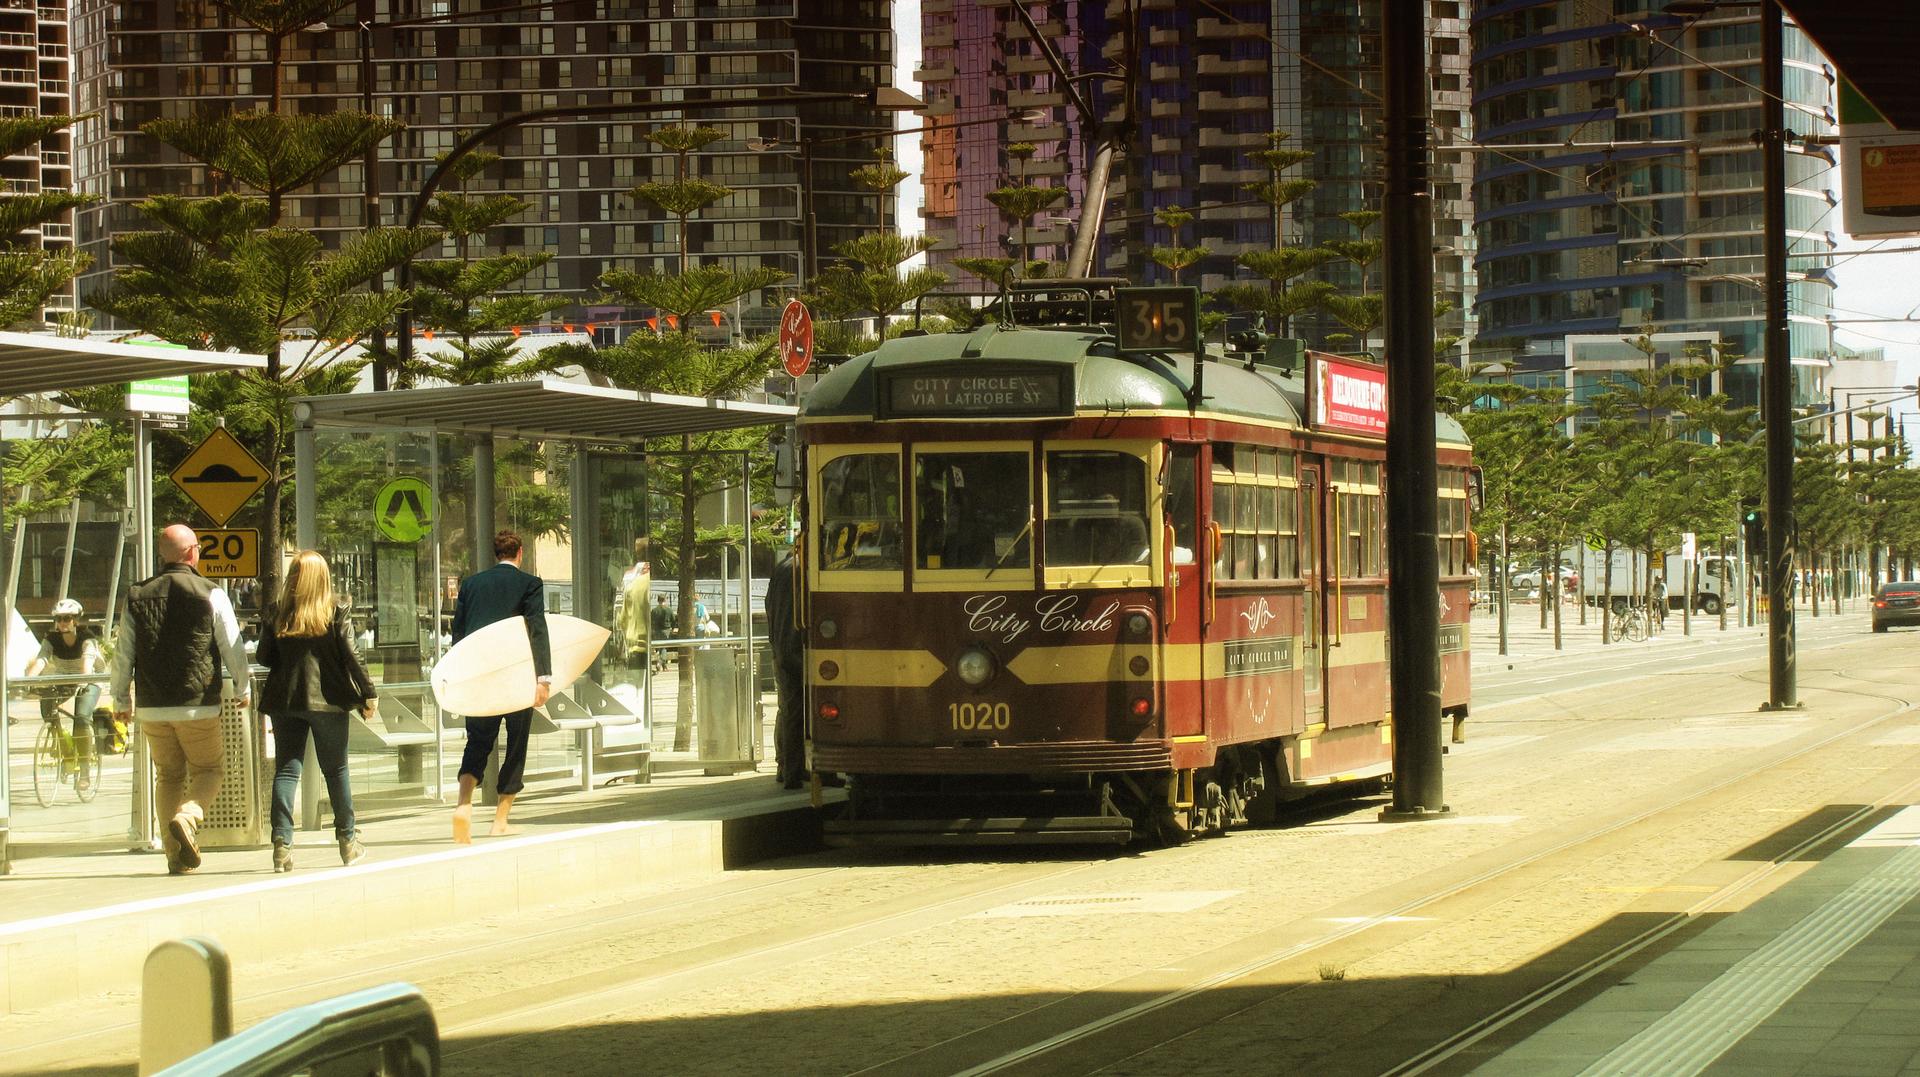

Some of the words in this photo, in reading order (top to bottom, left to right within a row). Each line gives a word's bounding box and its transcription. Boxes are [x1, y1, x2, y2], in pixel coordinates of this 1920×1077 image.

[1132, 300, 1186, 343] 35
[914, 378, 951, 391] CITY
[961, 377, 1018, 390] CIRCLE
[911, 393, 936, 406] VIA
[945, 392, 1014, 405] LATROBE
[1022, 391, 1042, 405] ST
[199, 534, 244, 560] 20
[206, 563, 237, 573] km/h
[963, 594, 1030, 644] City
[1035, 594, 1121, 633] Circle
[1229, 653, 1245, 665] CITY
[1248, 651, 1271, 663] CIRCLE
[1274, 649, 1288, 661] TRAM
[948, 702, 1010, 731] 1020
